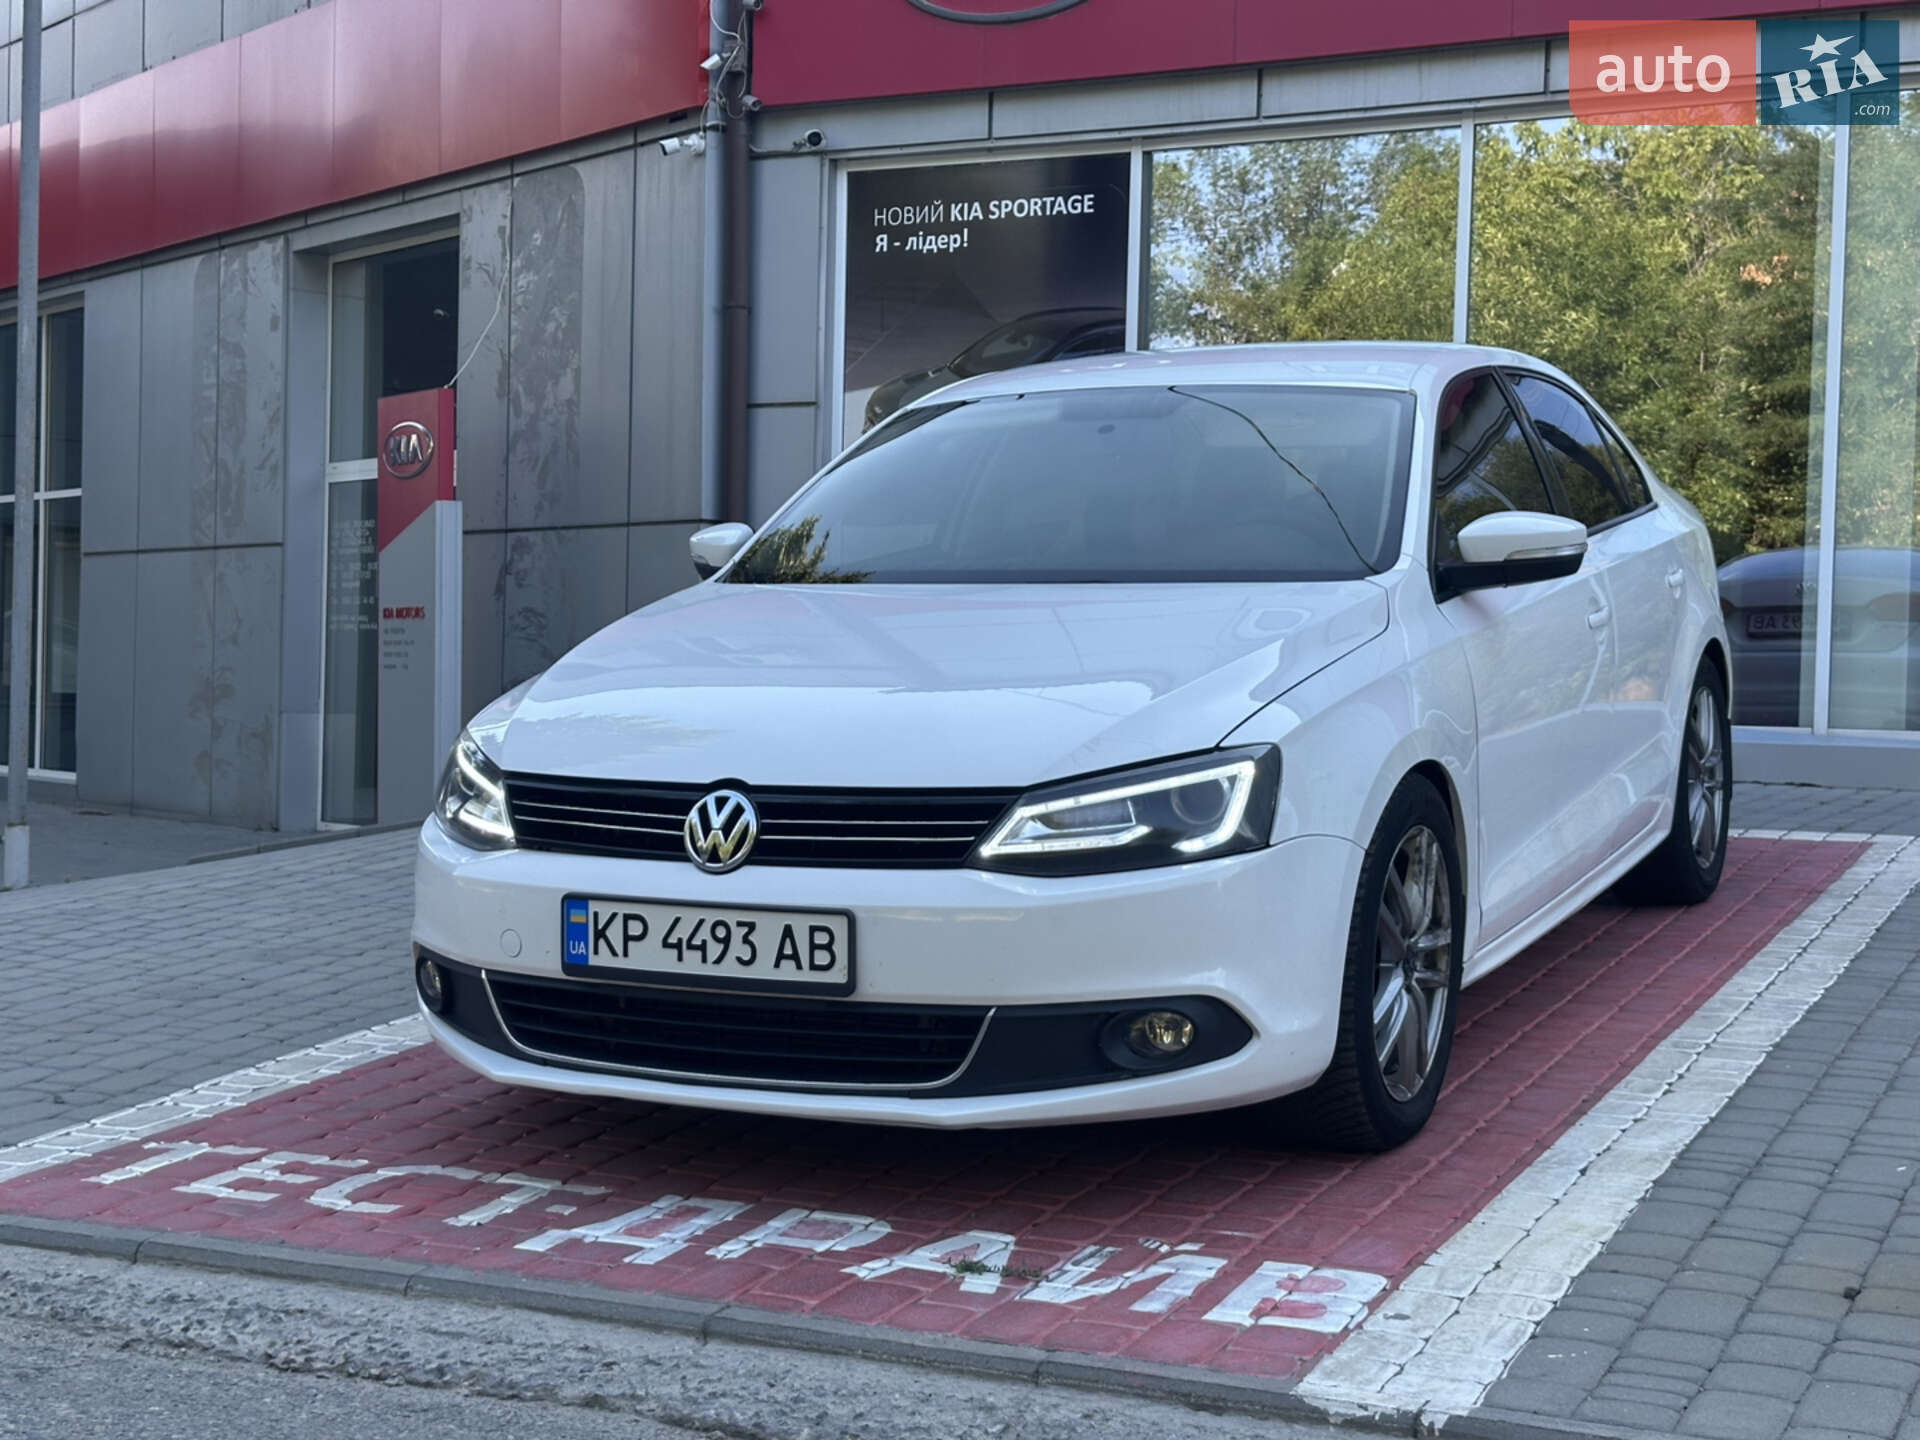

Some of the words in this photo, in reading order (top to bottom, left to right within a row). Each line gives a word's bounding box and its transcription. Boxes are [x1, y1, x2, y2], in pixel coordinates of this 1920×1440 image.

[873, 199, 944, 227] НОВИЙ
[950, 202, 984, 222] KIA
[988, 194, 1095, 219] SPORTAGE
[875, 233, 888, 252] Я
[905, 227, 968, 253] лідер!
[389, 433, 423, 464] KIA
[569, 940, 587, 955] UA
[592, 910, 649, 958] KP
[661, 916, 758, 966] 4493
[773, 923, 836, 972] AB
